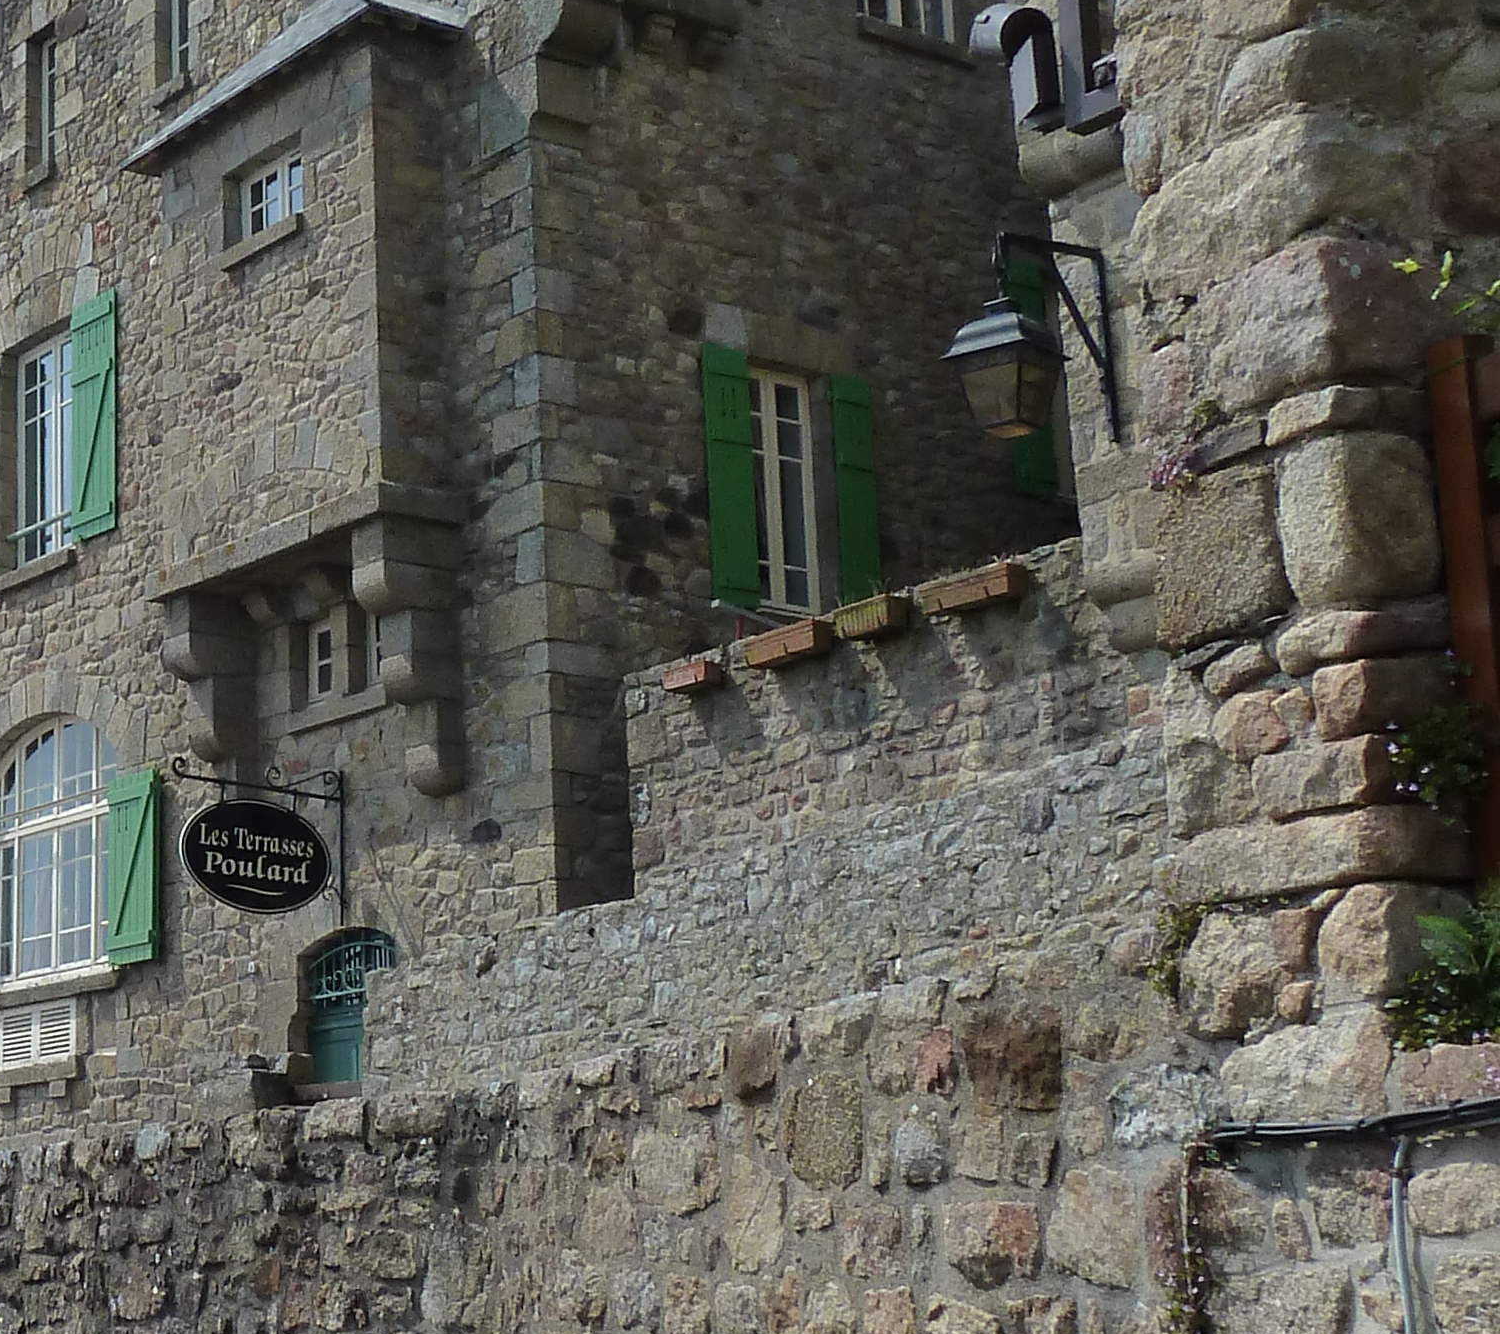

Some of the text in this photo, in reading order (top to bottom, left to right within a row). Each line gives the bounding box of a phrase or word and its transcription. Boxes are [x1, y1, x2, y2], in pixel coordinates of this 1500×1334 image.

[199, 823, 314, 858] Les Terrasses
[203, 851, 311, 885] Poulard
